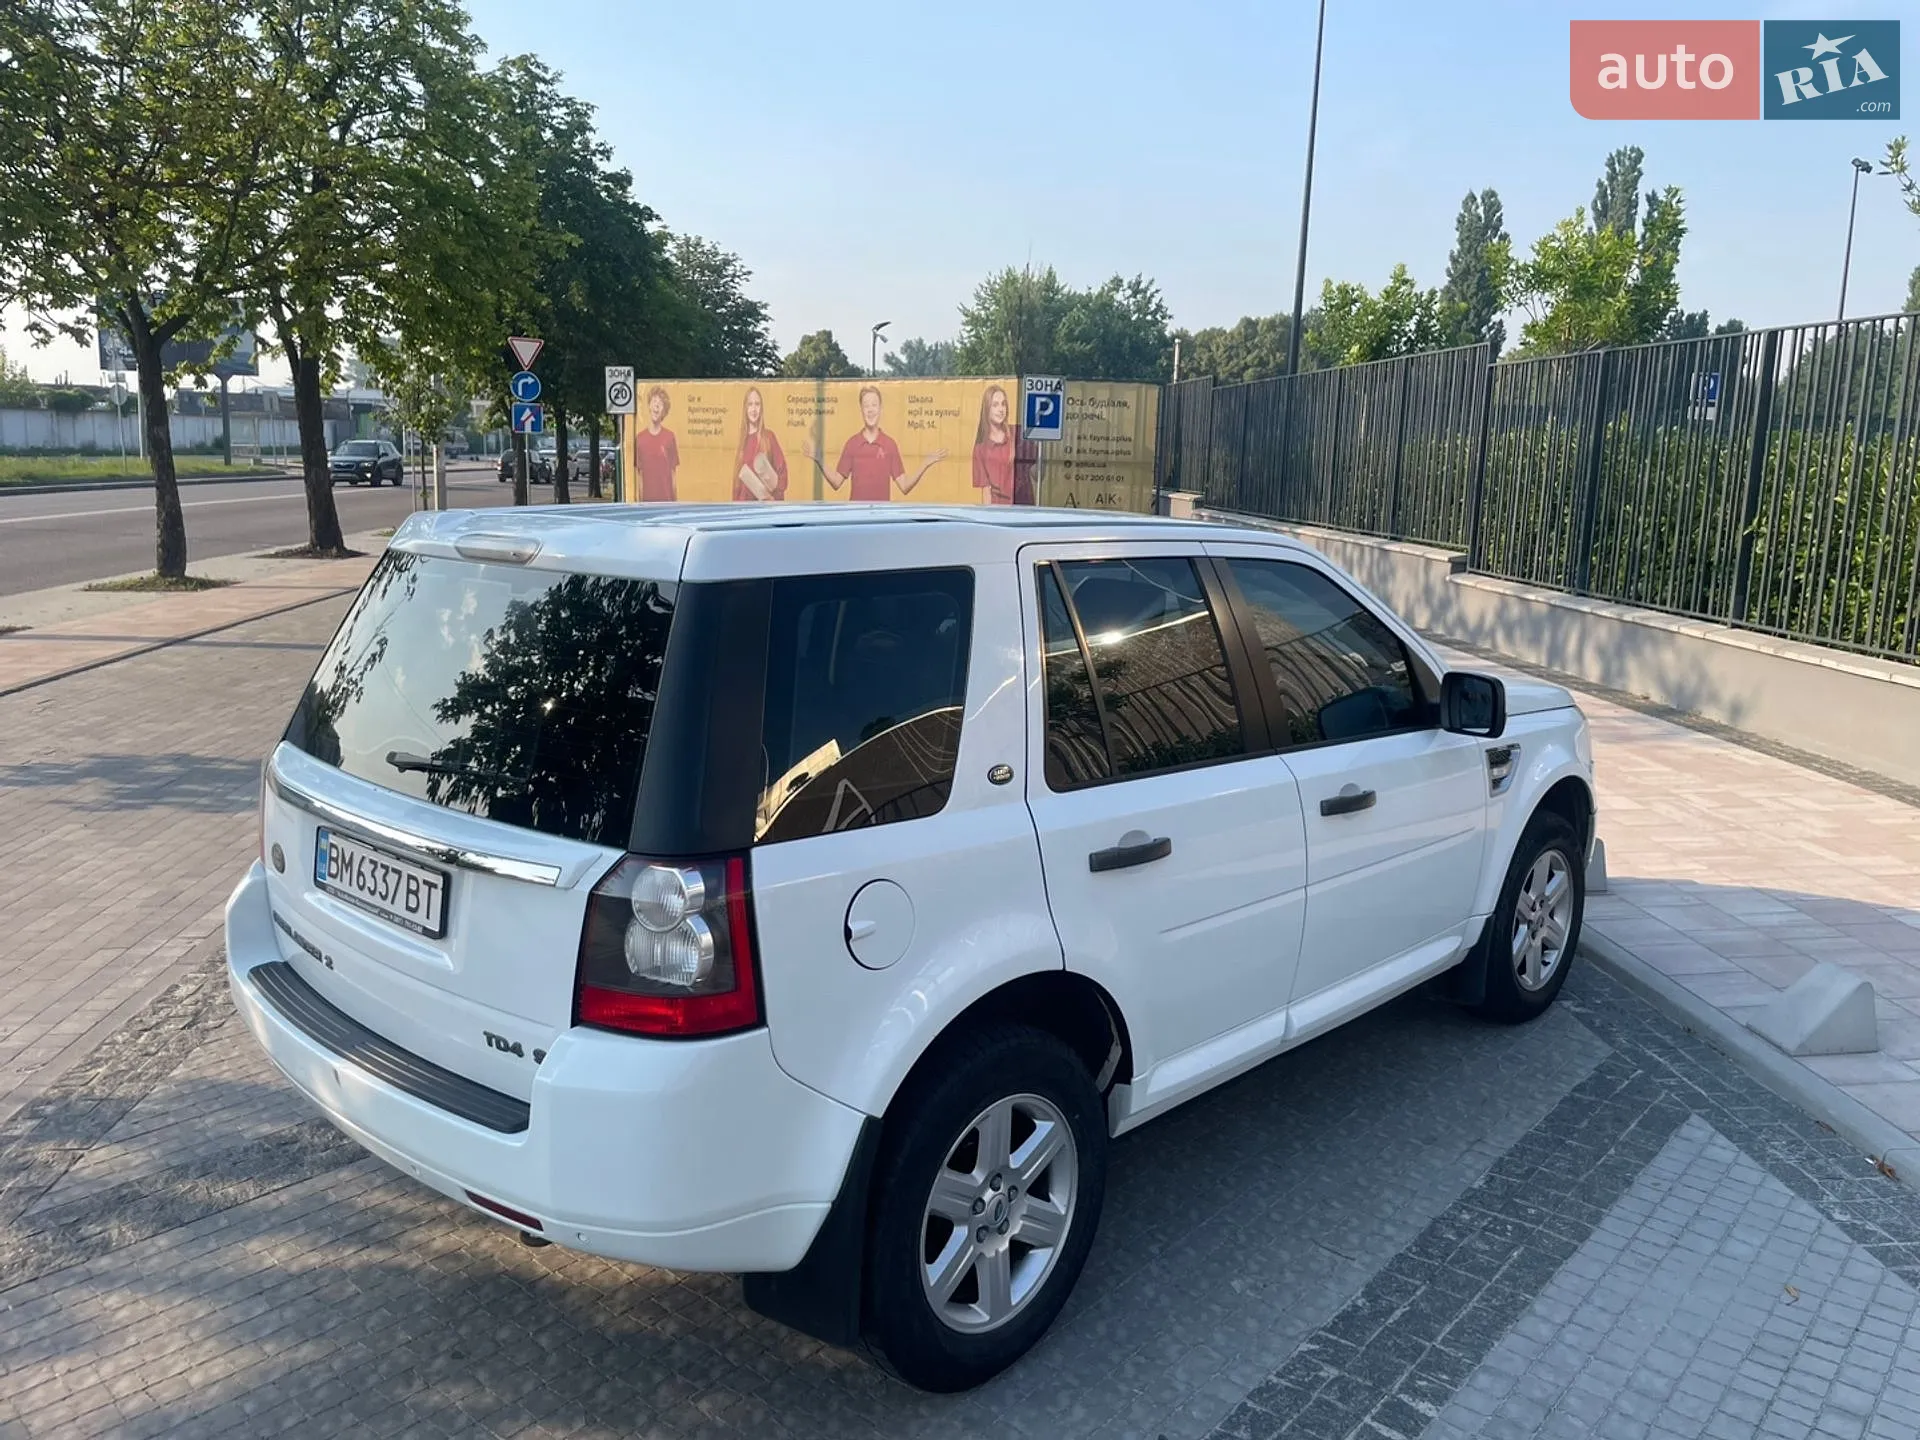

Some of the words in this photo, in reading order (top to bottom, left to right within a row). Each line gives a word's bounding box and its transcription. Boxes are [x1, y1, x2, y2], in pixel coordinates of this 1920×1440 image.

[608, 368, 632, 379] ЗОНА
[1026, 379, 1063, 392] ЗОНА
[613, 387, 628, 400] 20
[1034, 396, 1054, 426] P
[482, 1030, 524, 1058] TD4
